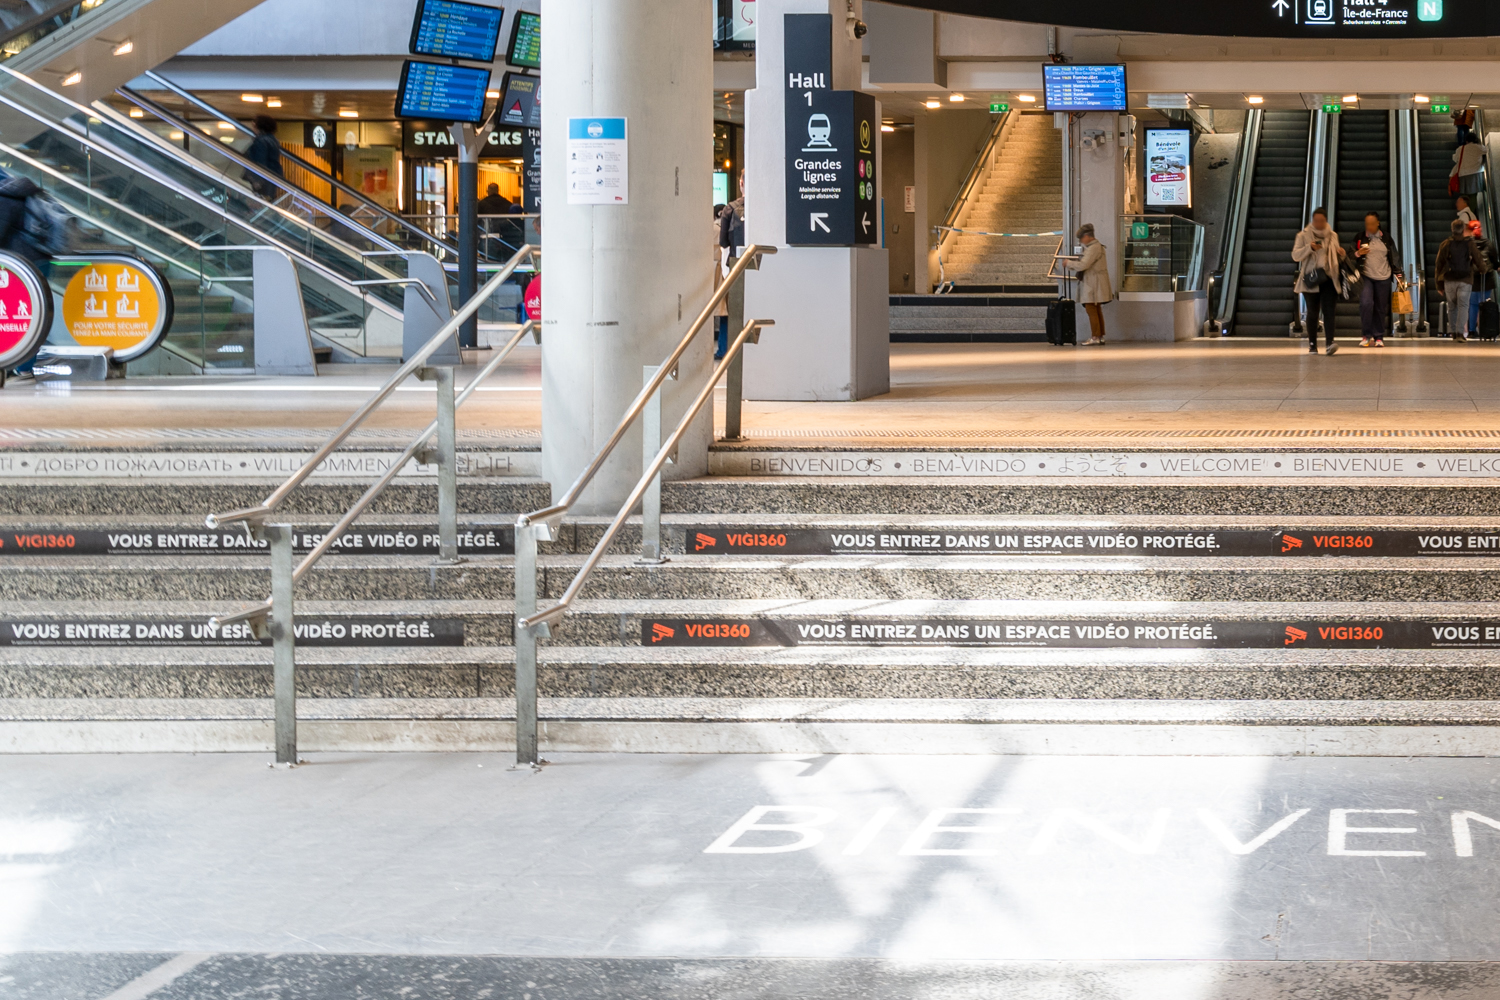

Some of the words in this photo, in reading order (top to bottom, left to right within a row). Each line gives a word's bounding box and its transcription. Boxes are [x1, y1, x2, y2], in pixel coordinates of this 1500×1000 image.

[1343, 6, 1408, 18] Île-de-France
[482, 15, 497, 61] départs
[789, 72, 826, 88] Hall
[469, 71, 485, 119] départs
[803, 91, 813, 106] 1
[414, 131, 522, 146] STACKS
[795, 158, 842, 170] Grandes
[803, 170, 837, 185] lignes
[74, 322, 93, 330] POUR
[94, 322, 116, 330] VOTRE
[117, 321, 149, 330] SÉCURITÉ
[35, 458, 99, 473] ДОБРО
[104, 456, 234, 473] ПОЖАЛОВАТЬ
[750, 457, 883, 473] BIENVENIDOS
[913, 458, 1026, 473] BEM-VINDO
[1057, 456, 1128, 474] ようこそ
[1160, 458, 1261, 473] WELCOME
[1293, 458, 1404, 473] BIENVENUE
[15, 534, 75, 548] VIGI360
[108, 534, 153, 548] VOUS
[158, 534, 219, 548] ENTREZ
[368, 531, 418, 548] VIDÉO
[423, 531, 501, 548] PRTÉGÉ.
[726, 534, 787, 547] VIGI360
[831, 534, 876, 548] VOUS
[881, 534, 941, 548] ENTREZ
[946, 534, 990, 548] DANS
[995, 534, 1019, 548] UN
[1024, 534, 1083, 548] ESPACE
[1088, 531, 1138, 548] VIDÉO
[1144, 531, 1220, 548] PROTÉGÉ.
[1312, 535, 1374, 548] VIGI360
[1419, 536, 1463, 549] VOUS
[11, 624, 60, 639] VOUS
[65, 624, 131, 639] ENTREZ
[135, 624, 184, 639] DANS
[293, 620, 346, 639] VIDÉO
[352, 620, 435, 639] PROTÉGÉ.
[686, 624, 751, 638] VIGI360
[798, 625, 846, 639] VOUS
[852, 625, 917, 639] ENTREZ
[922, 625, 970, 639] DANS
[975, 625, 1001, 639] UN
[1006, 625, 1071, 639] ESPACE
[1075, 622, 1130, 639] VIDÉO
[1135, 622, 1218, 639] PROTÉGÉ.
[1318, 626, 1384, 640] VIGI360
[1432, 627, 1480, 640] VOUS
